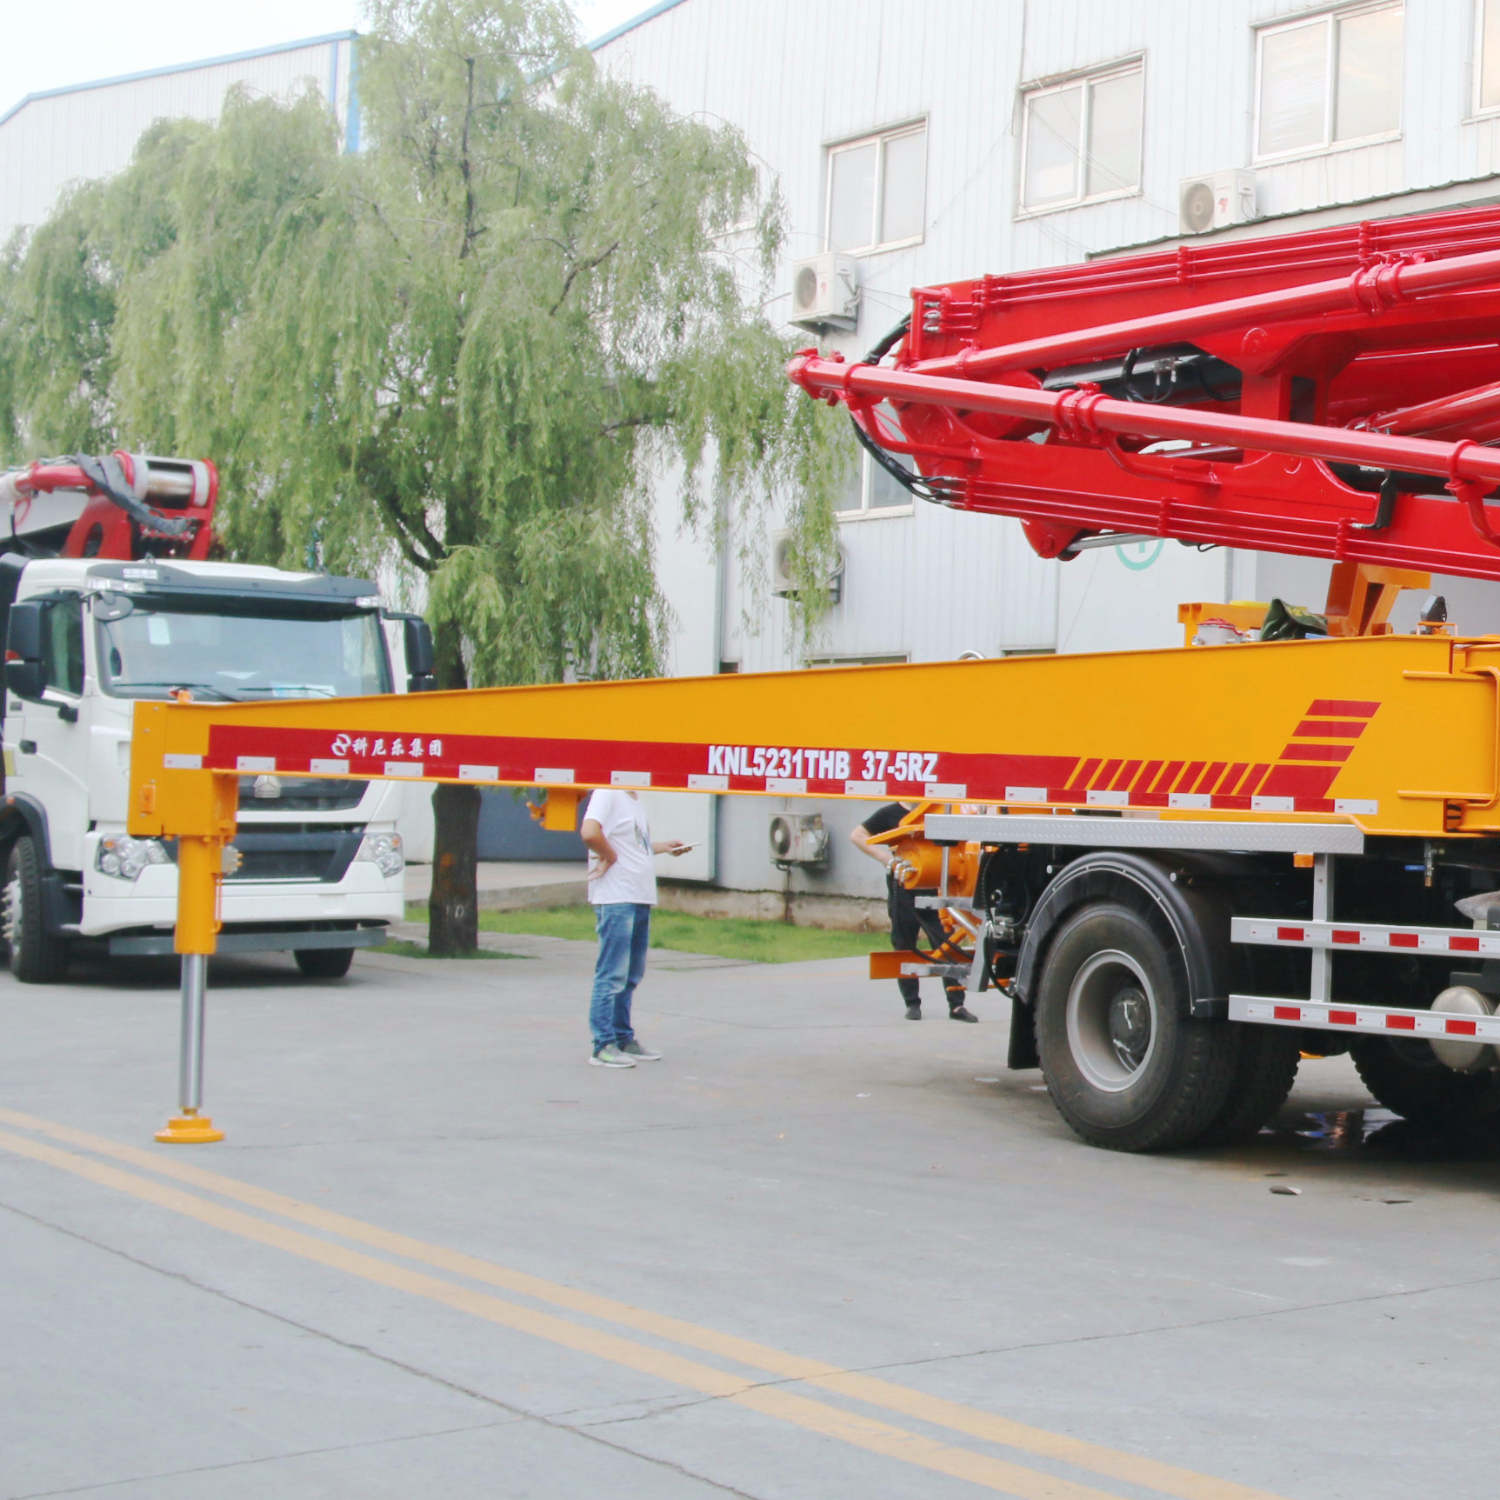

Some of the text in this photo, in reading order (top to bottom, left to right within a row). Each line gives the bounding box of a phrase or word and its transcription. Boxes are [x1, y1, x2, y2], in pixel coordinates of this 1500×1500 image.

[352, 737, 442, 757] 科尼乐集团
[707, 745, 939, 782] KNL5231THB 37-5RZ
